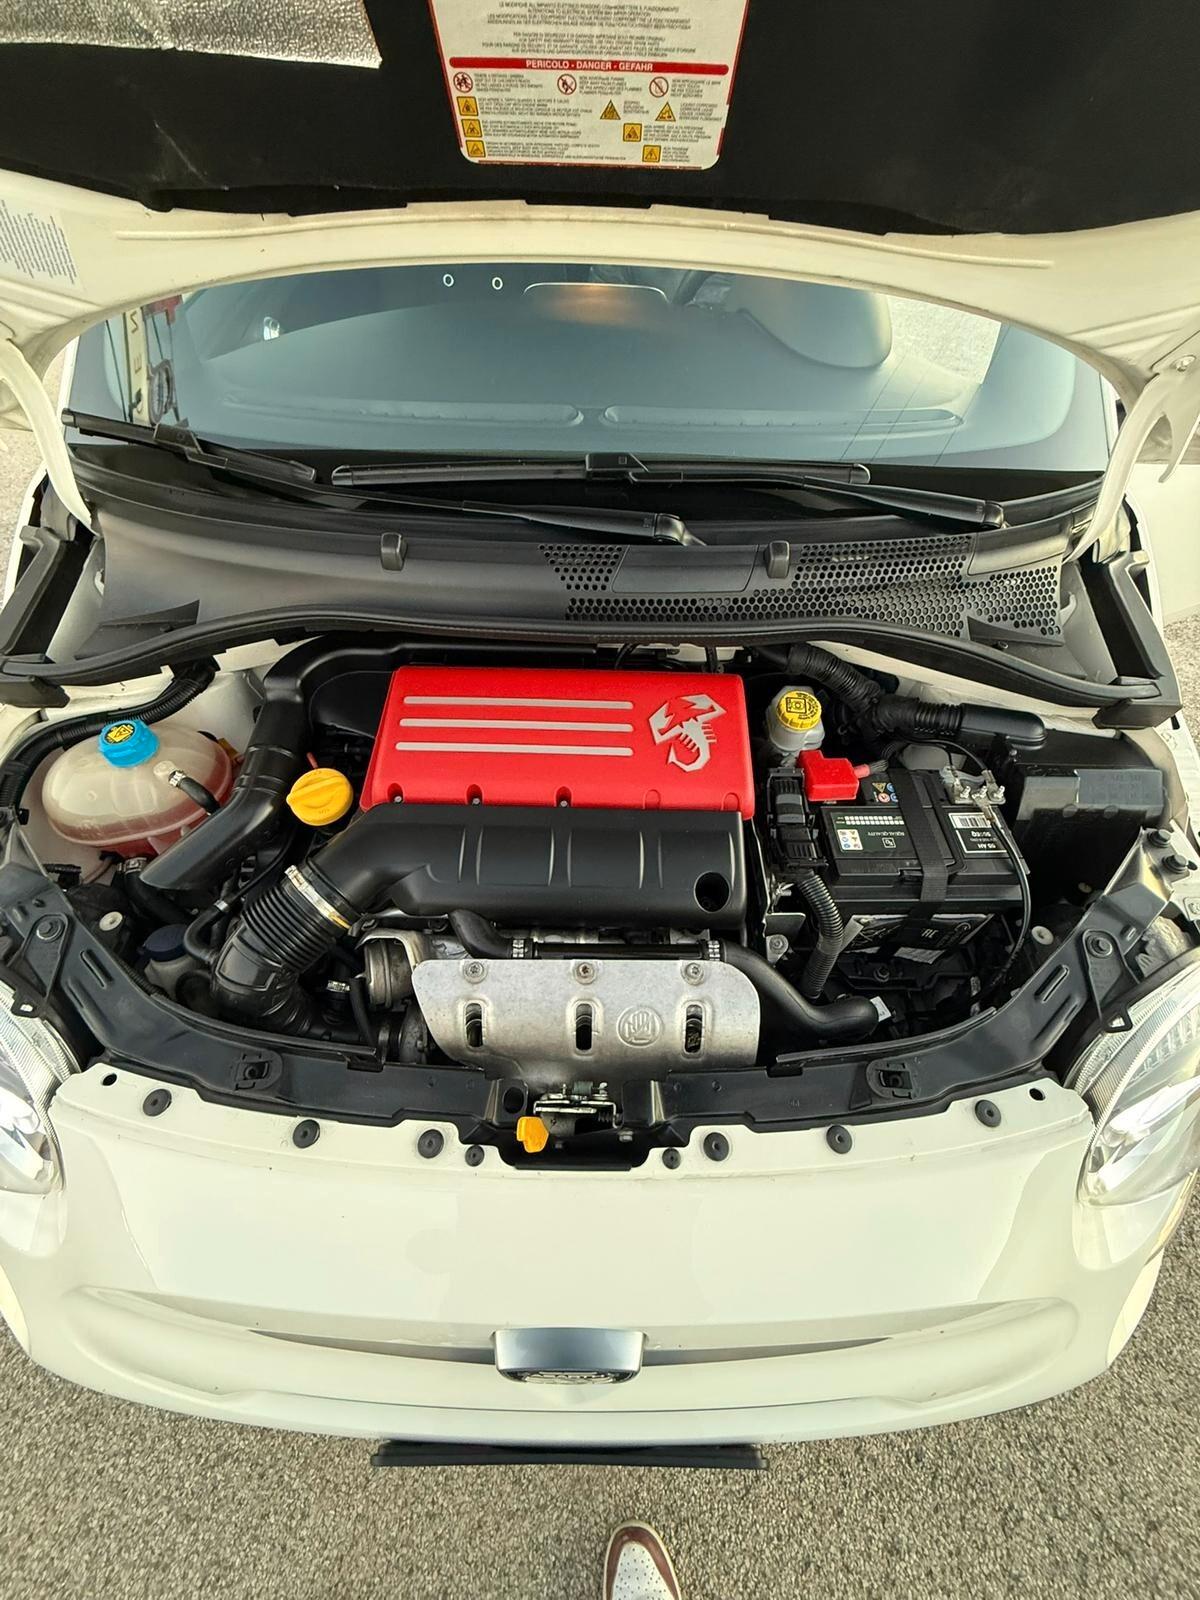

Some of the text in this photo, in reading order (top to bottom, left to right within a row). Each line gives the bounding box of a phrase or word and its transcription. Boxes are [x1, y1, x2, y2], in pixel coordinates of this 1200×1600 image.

[526, 60, 569, 69] PERICOLO
[576, 61, 612, 70] DANGER
[618, 62, 653, 71] GEFAHR
